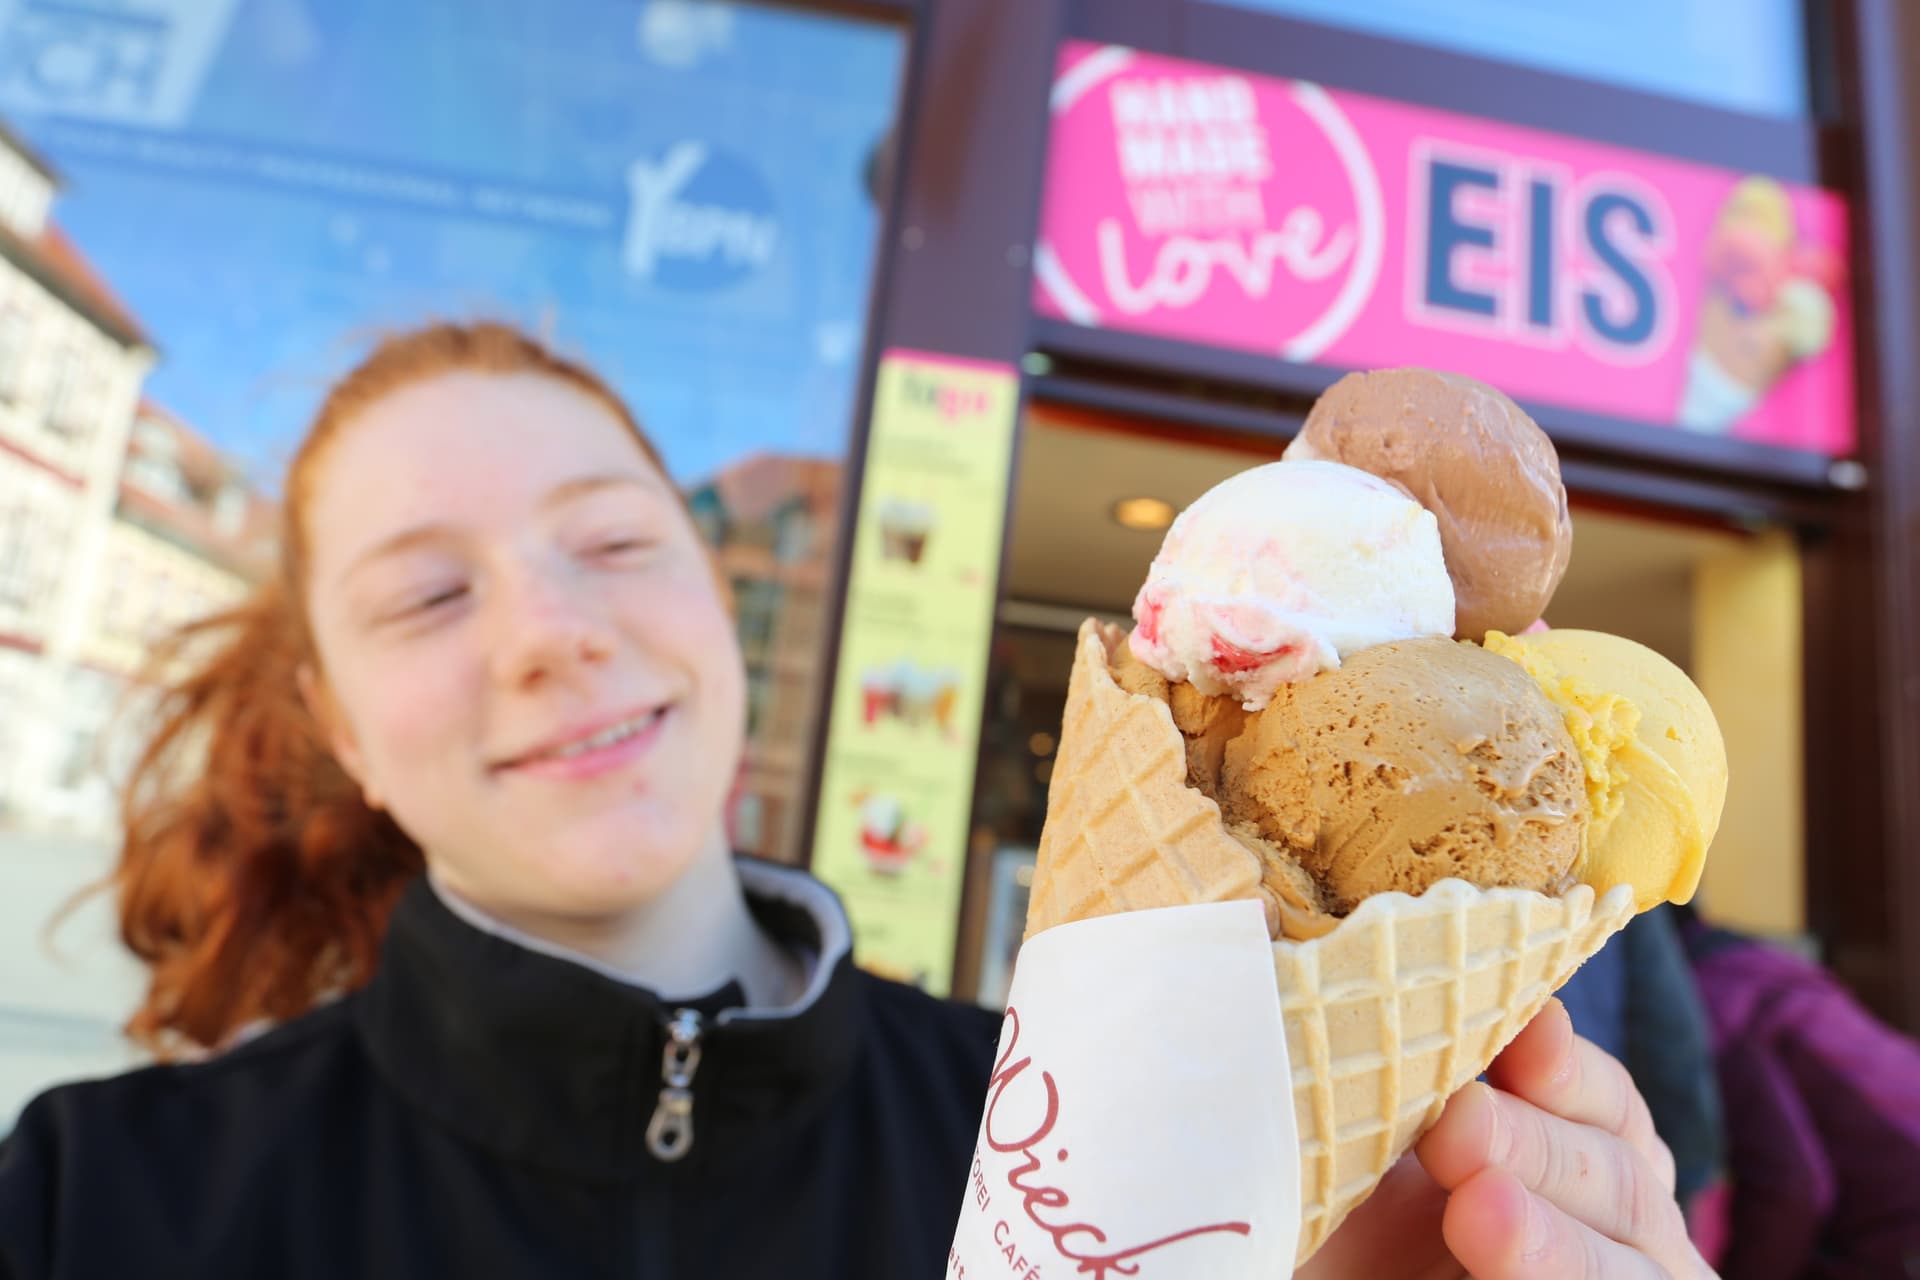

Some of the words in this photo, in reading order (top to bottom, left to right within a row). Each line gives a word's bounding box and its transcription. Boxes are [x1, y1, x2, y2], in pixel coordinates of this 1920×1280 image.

[1109, 77, 1257, 122] HAND
[1121, 126, 1274, 180] MADE
[1418, 152, 1664, 353] EIS
[973, 1146, 991, 1212] OREI
